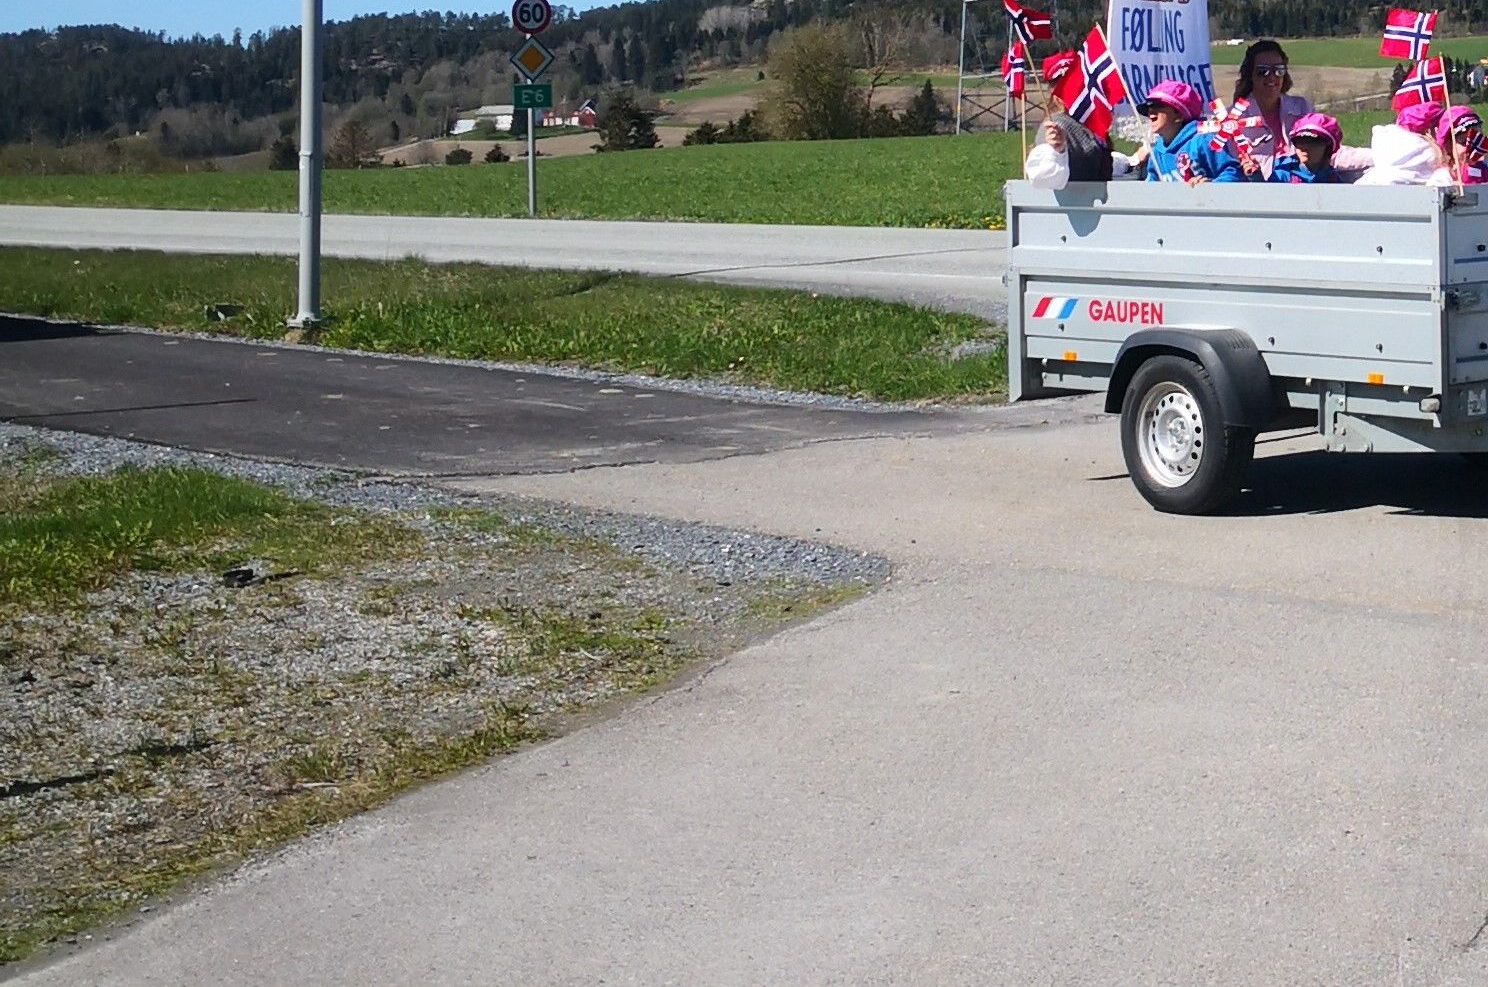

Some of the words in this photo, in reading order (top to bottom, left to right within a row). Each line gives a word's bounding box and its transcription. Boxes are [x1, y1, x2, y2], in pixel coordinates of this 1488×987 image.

[519, 3, 544, 23] 60
[521, 89, 544, 103] E6
[1117, 63, 1213, 109] ARNGE
[1088, 299, 1163, 325] GAUPEN
